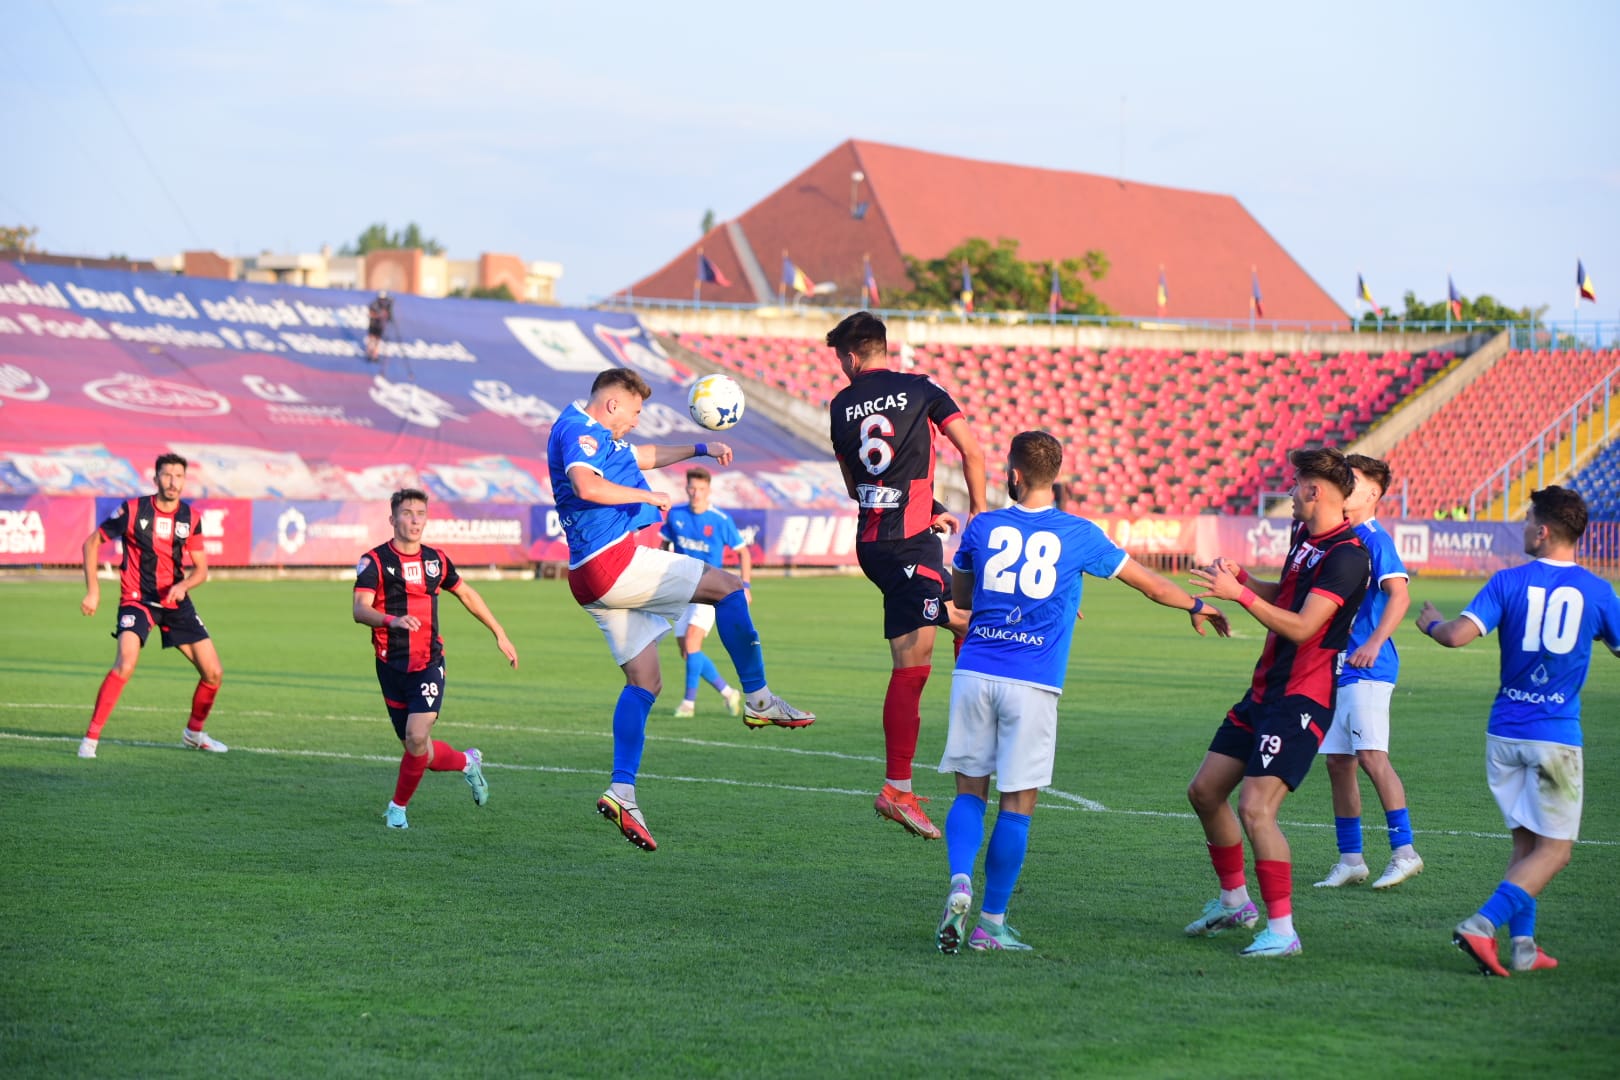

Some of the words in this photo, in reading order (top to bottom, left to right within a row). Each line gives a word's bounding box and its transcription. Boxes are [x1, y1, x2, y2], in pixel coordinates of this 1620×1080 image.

[65, 282, 136, 314] bun
[133, 287, 199, 319] faci
[18, 313, 110, 340] Food
[859, 413, 896, 476] 6
[1433, 532, 1493, 550] MARTY
[983, 525, 1062, 600] 28
[1522, 585, 1584, 654] 10
[420, 682, 439, 697] 28
[1259, 734, 1282, 754] 79
